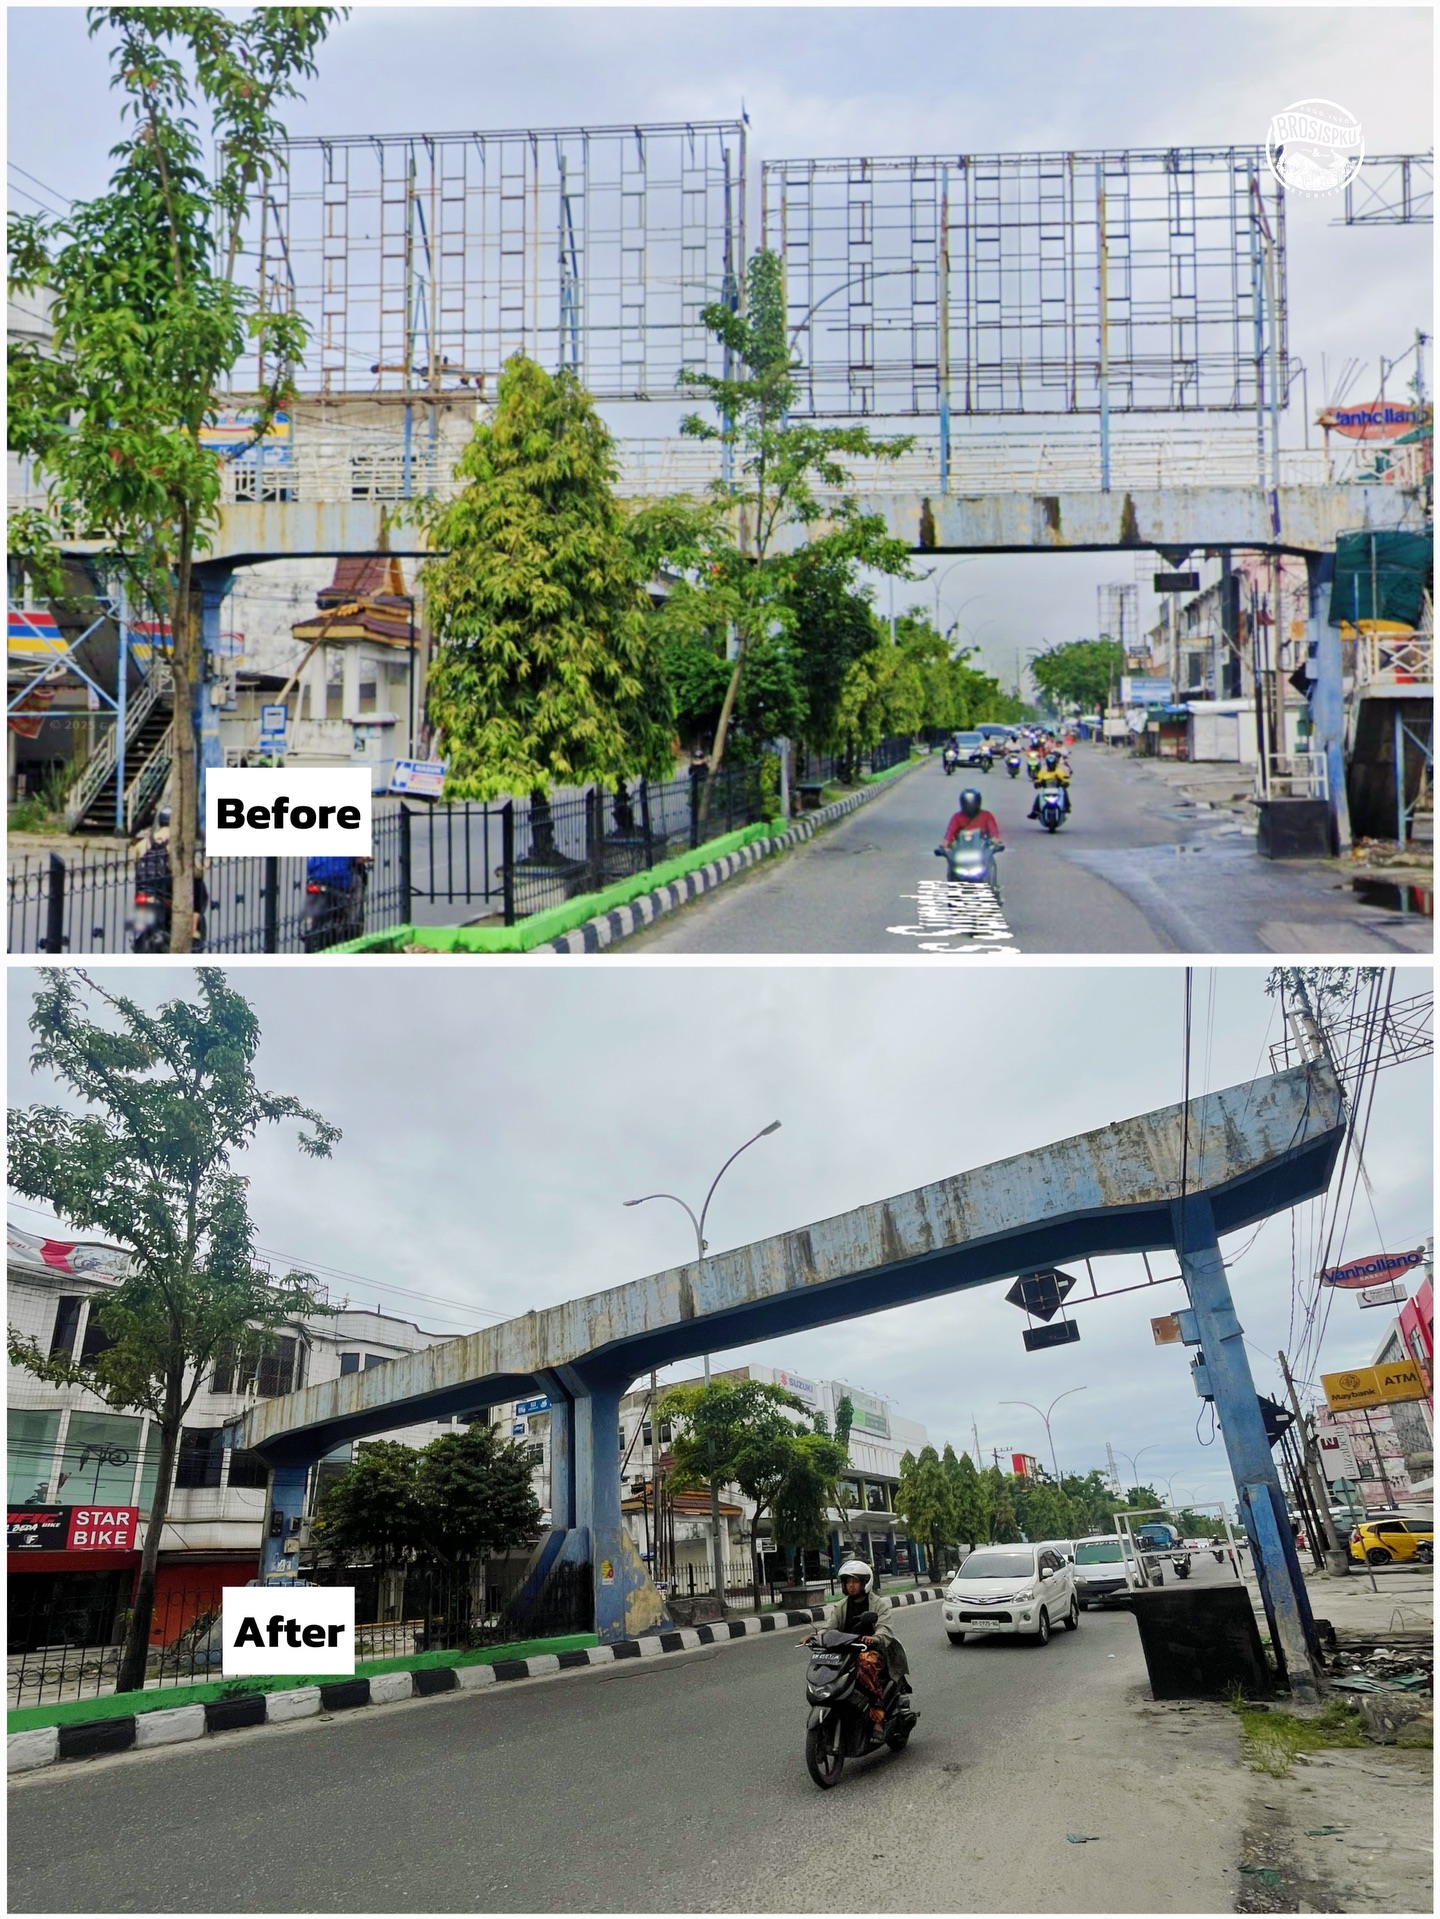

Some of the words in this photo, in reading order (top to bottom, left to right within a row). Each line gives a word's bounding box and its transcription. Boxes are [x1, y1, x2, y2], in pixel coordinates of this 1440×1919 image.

[1323, 1253, 1419, 1282] Vanhollano
[788, 1377, 814, 1393] SUZUKI
[1384, 1373, 1417, 1386] ATM
[1331, 1388, 1376, 1402] Maybank
[1334, 1426, 1357, 1477] Elizabeth
[76, 1511, 130, 1526] STAR
[73, 1531, 128, 1545] BIKE
